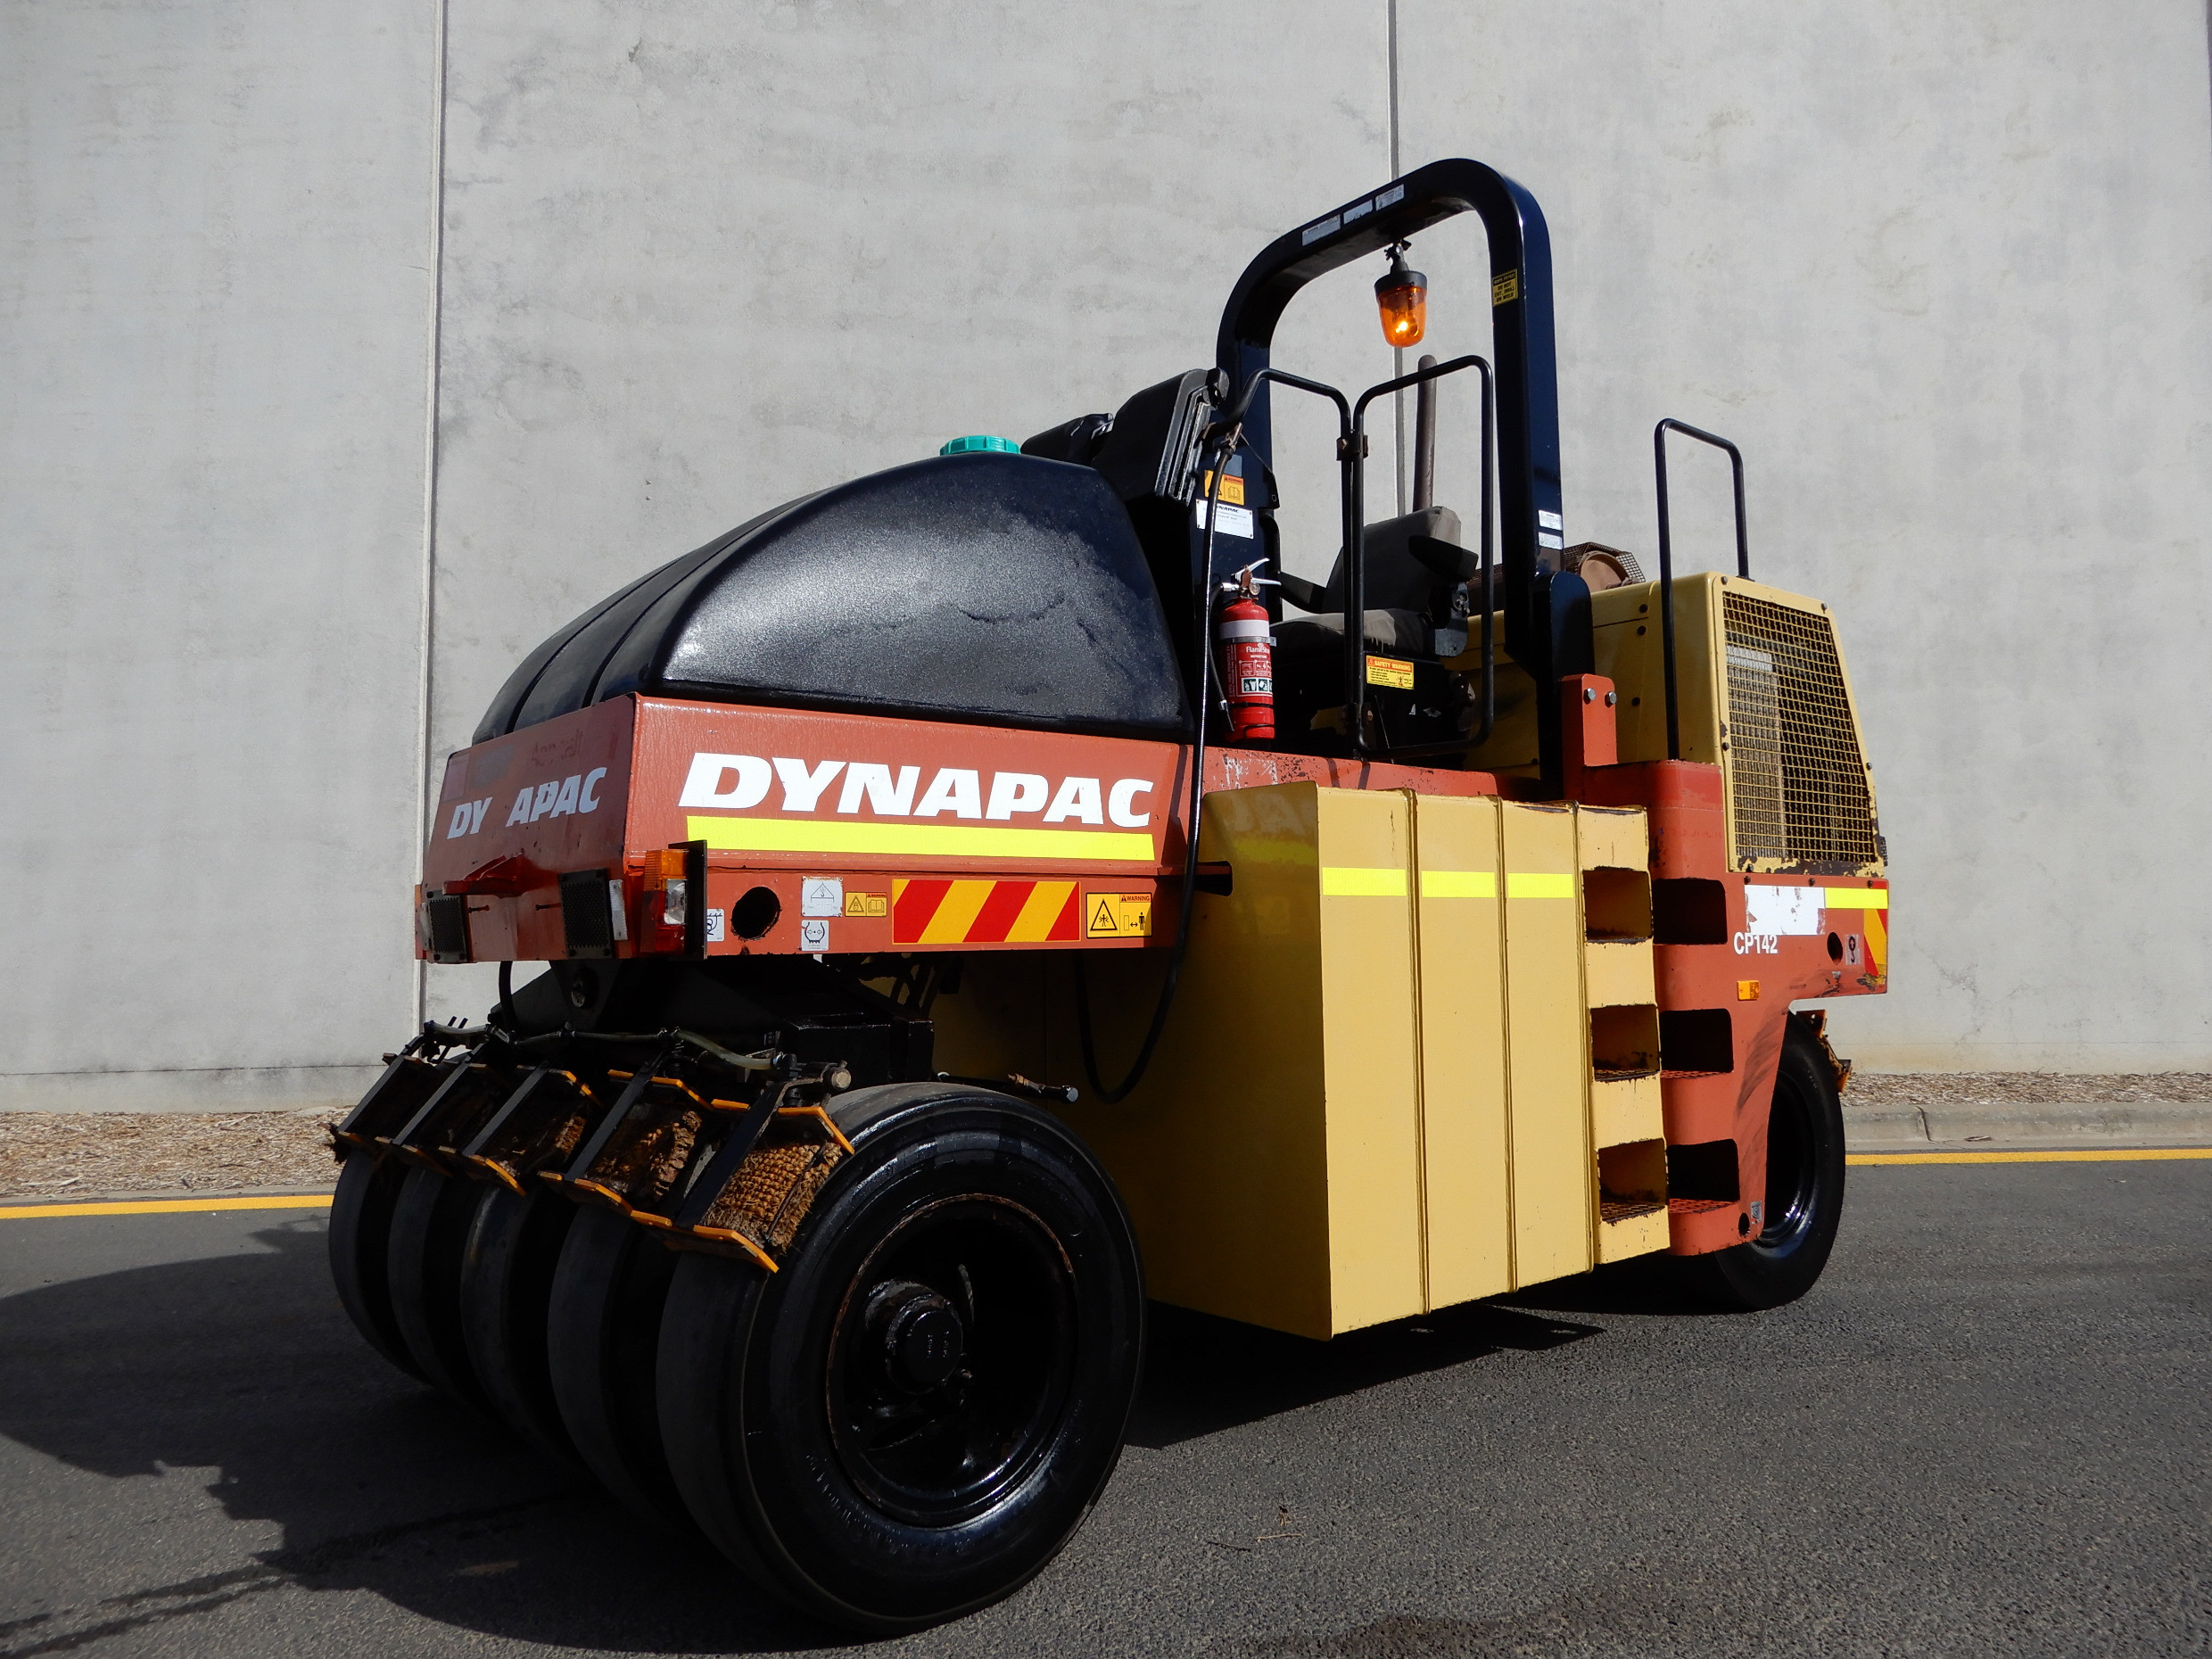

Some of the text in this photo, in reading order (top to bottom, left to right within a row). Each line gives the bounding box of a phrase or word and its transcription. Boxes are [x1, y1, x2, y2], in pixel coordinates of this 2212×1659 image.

[1374, 660, 1411, 671] SAFETY WARNING
[447, 766, 607, 839] DY APAC
[679, 752, 1154, 827] DYNAPAC
[1733, 931, 1779, 955] CP142
